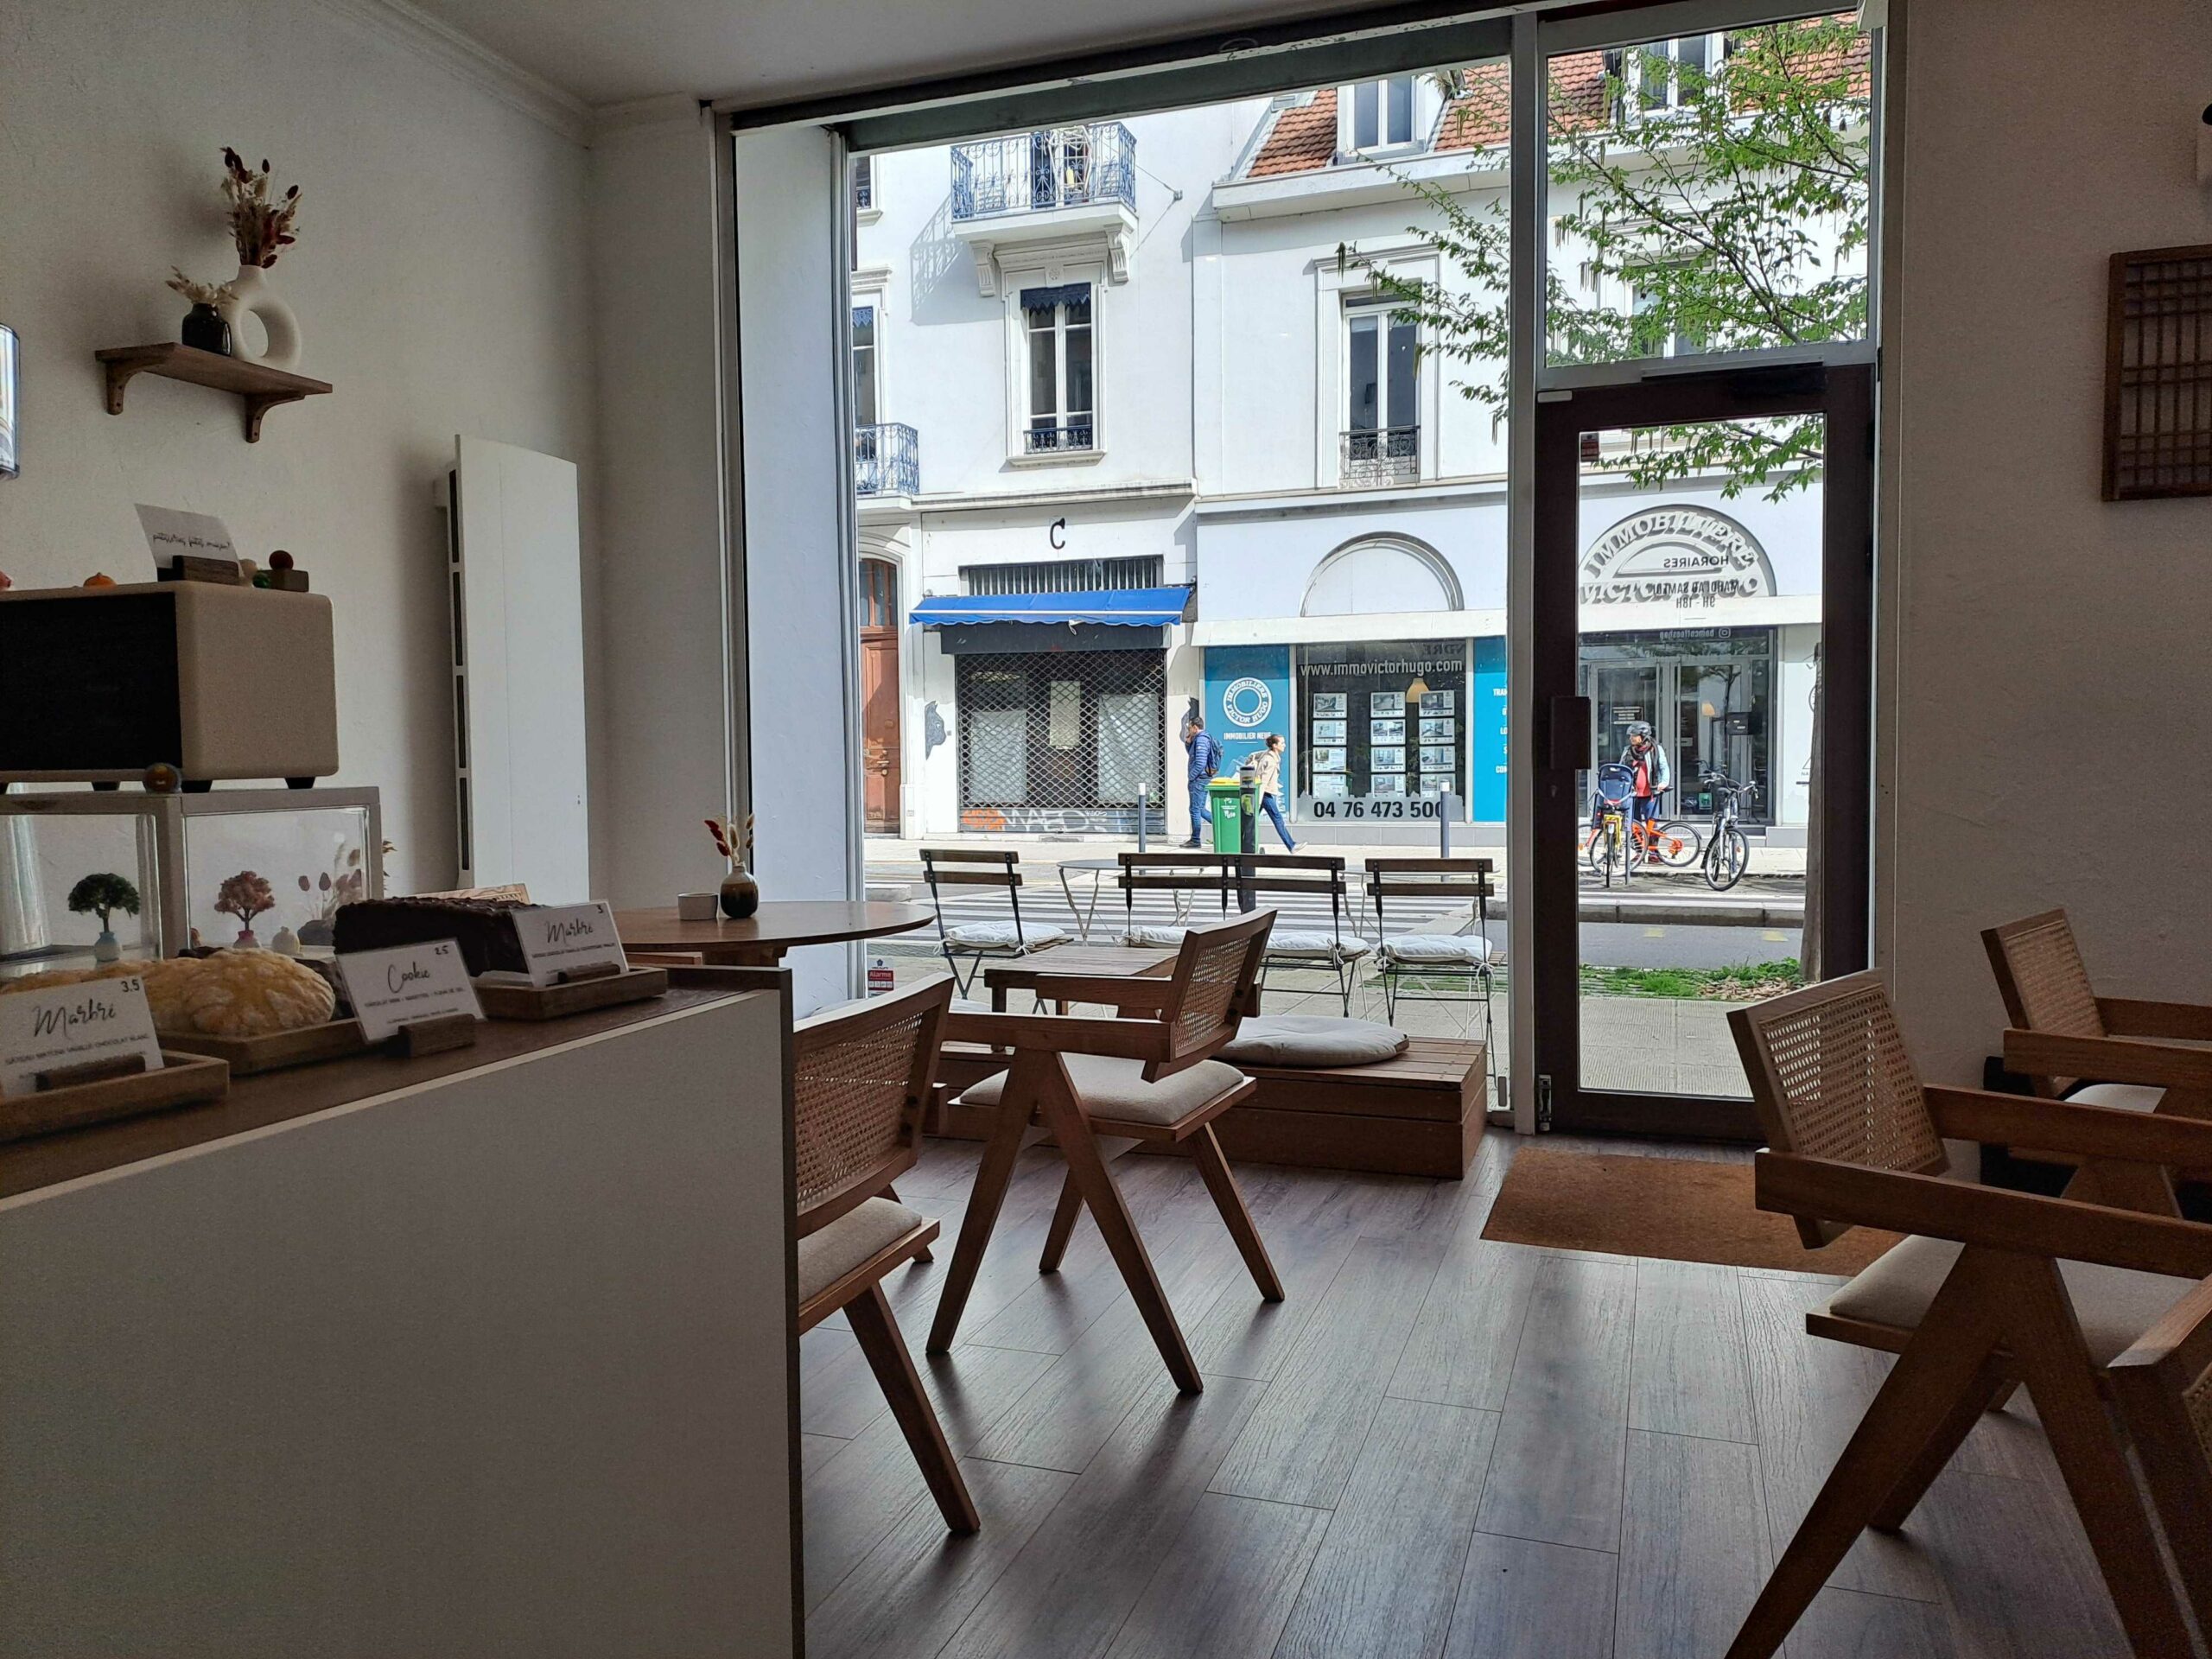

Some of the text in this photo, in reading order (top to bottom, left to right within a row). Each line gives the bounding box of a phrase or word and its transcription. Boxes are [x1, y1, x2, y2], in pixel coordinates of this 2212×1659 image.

[1300, 658, 1462, 676] www.immovictorhugo.com
[1227, 701, 1268, 722] VICTOR HUGO
[1224, 732, 1256, 741] IMMOBILIER
[1313, 801, 1336, 817] 04
[1343, 801, 1364, 817] 76
[1370, 801, 1403, 817] 473
[596, 905, 604, 913] 3
[388, 962, 430, 993] Cookie
[121, 979, 140, 993] 3.5
